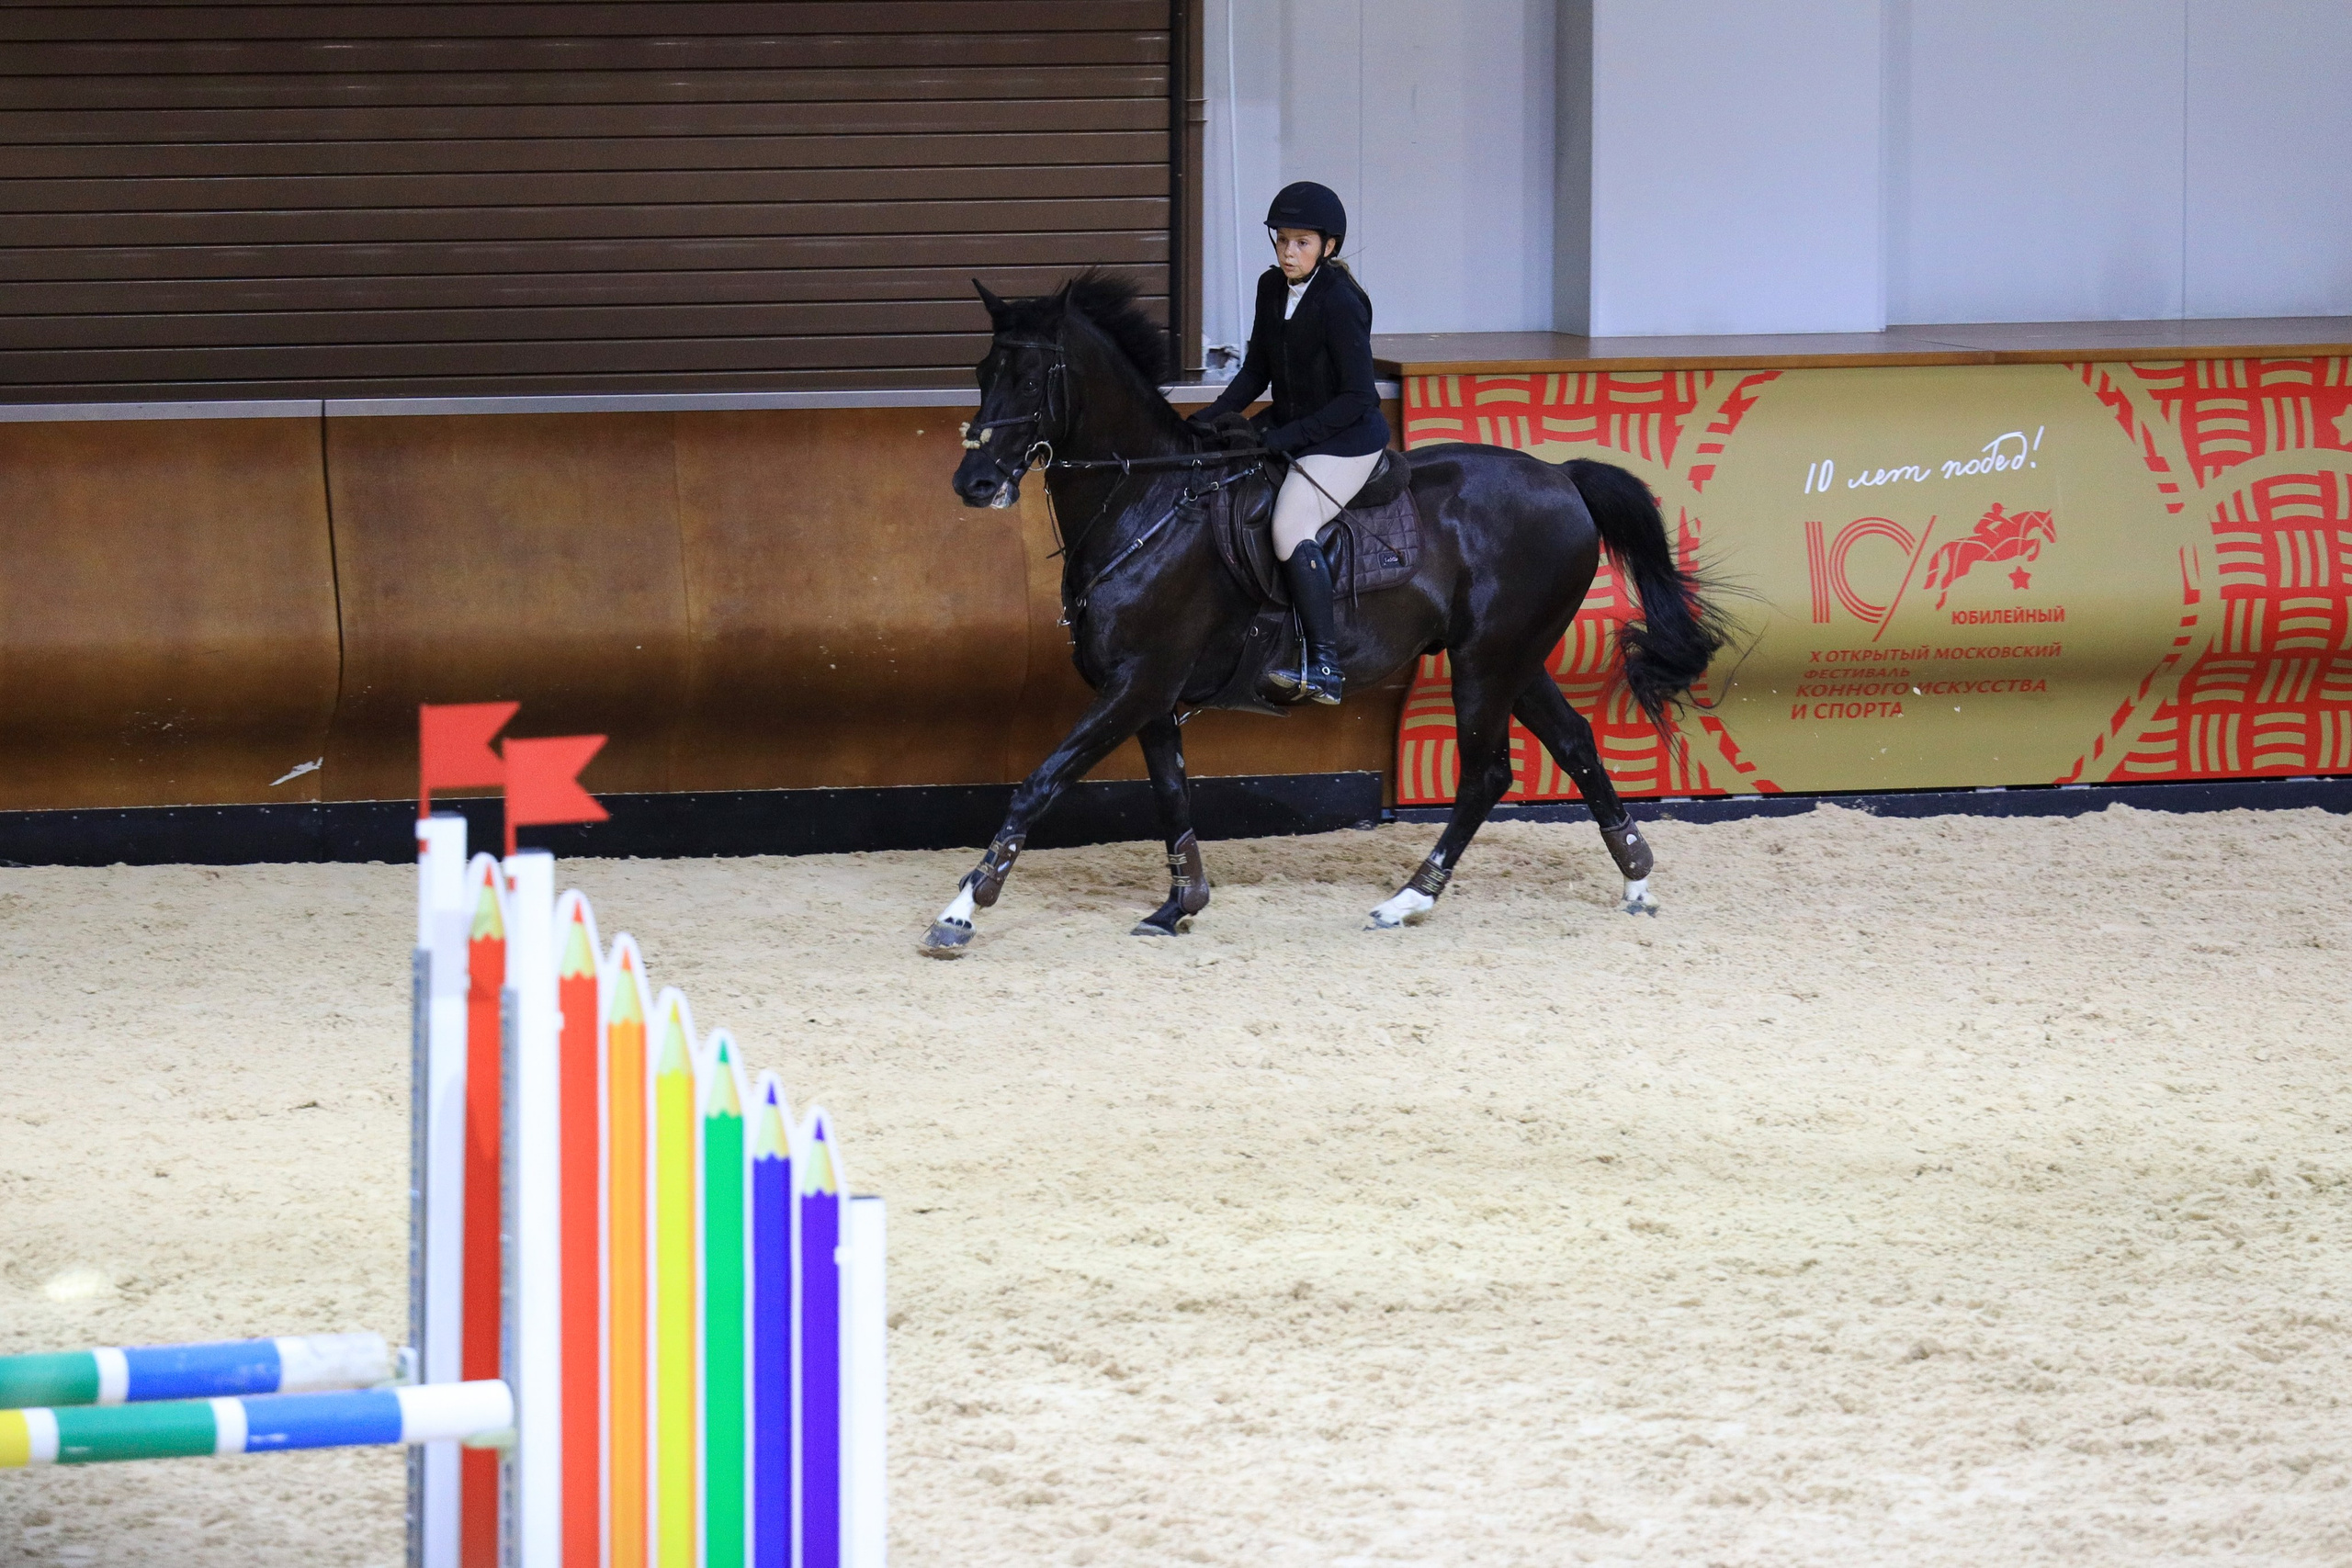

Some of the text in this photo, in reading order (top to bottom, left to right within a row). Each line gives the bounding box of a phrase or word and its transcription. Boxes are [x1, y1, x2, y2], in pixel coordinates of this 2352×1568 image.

[1804, 425, 2045, 494] 10 лет побед!
[1951, 605, 2065, 625] ЮБИЛЕЙНЫЙ
[1825, 644, 1930, 662] ОТКРЫТЫЙ
[1934, 641, 2063, 660] МОСКОВСКИЙ
[1804, 667, 1911, 679] ФЕСТИВАЛЬ
[1795, 678, 2048, 698] КОННОГО ИСКУССТВА
[1791, 701, 1904, 720] И СПОРТА
